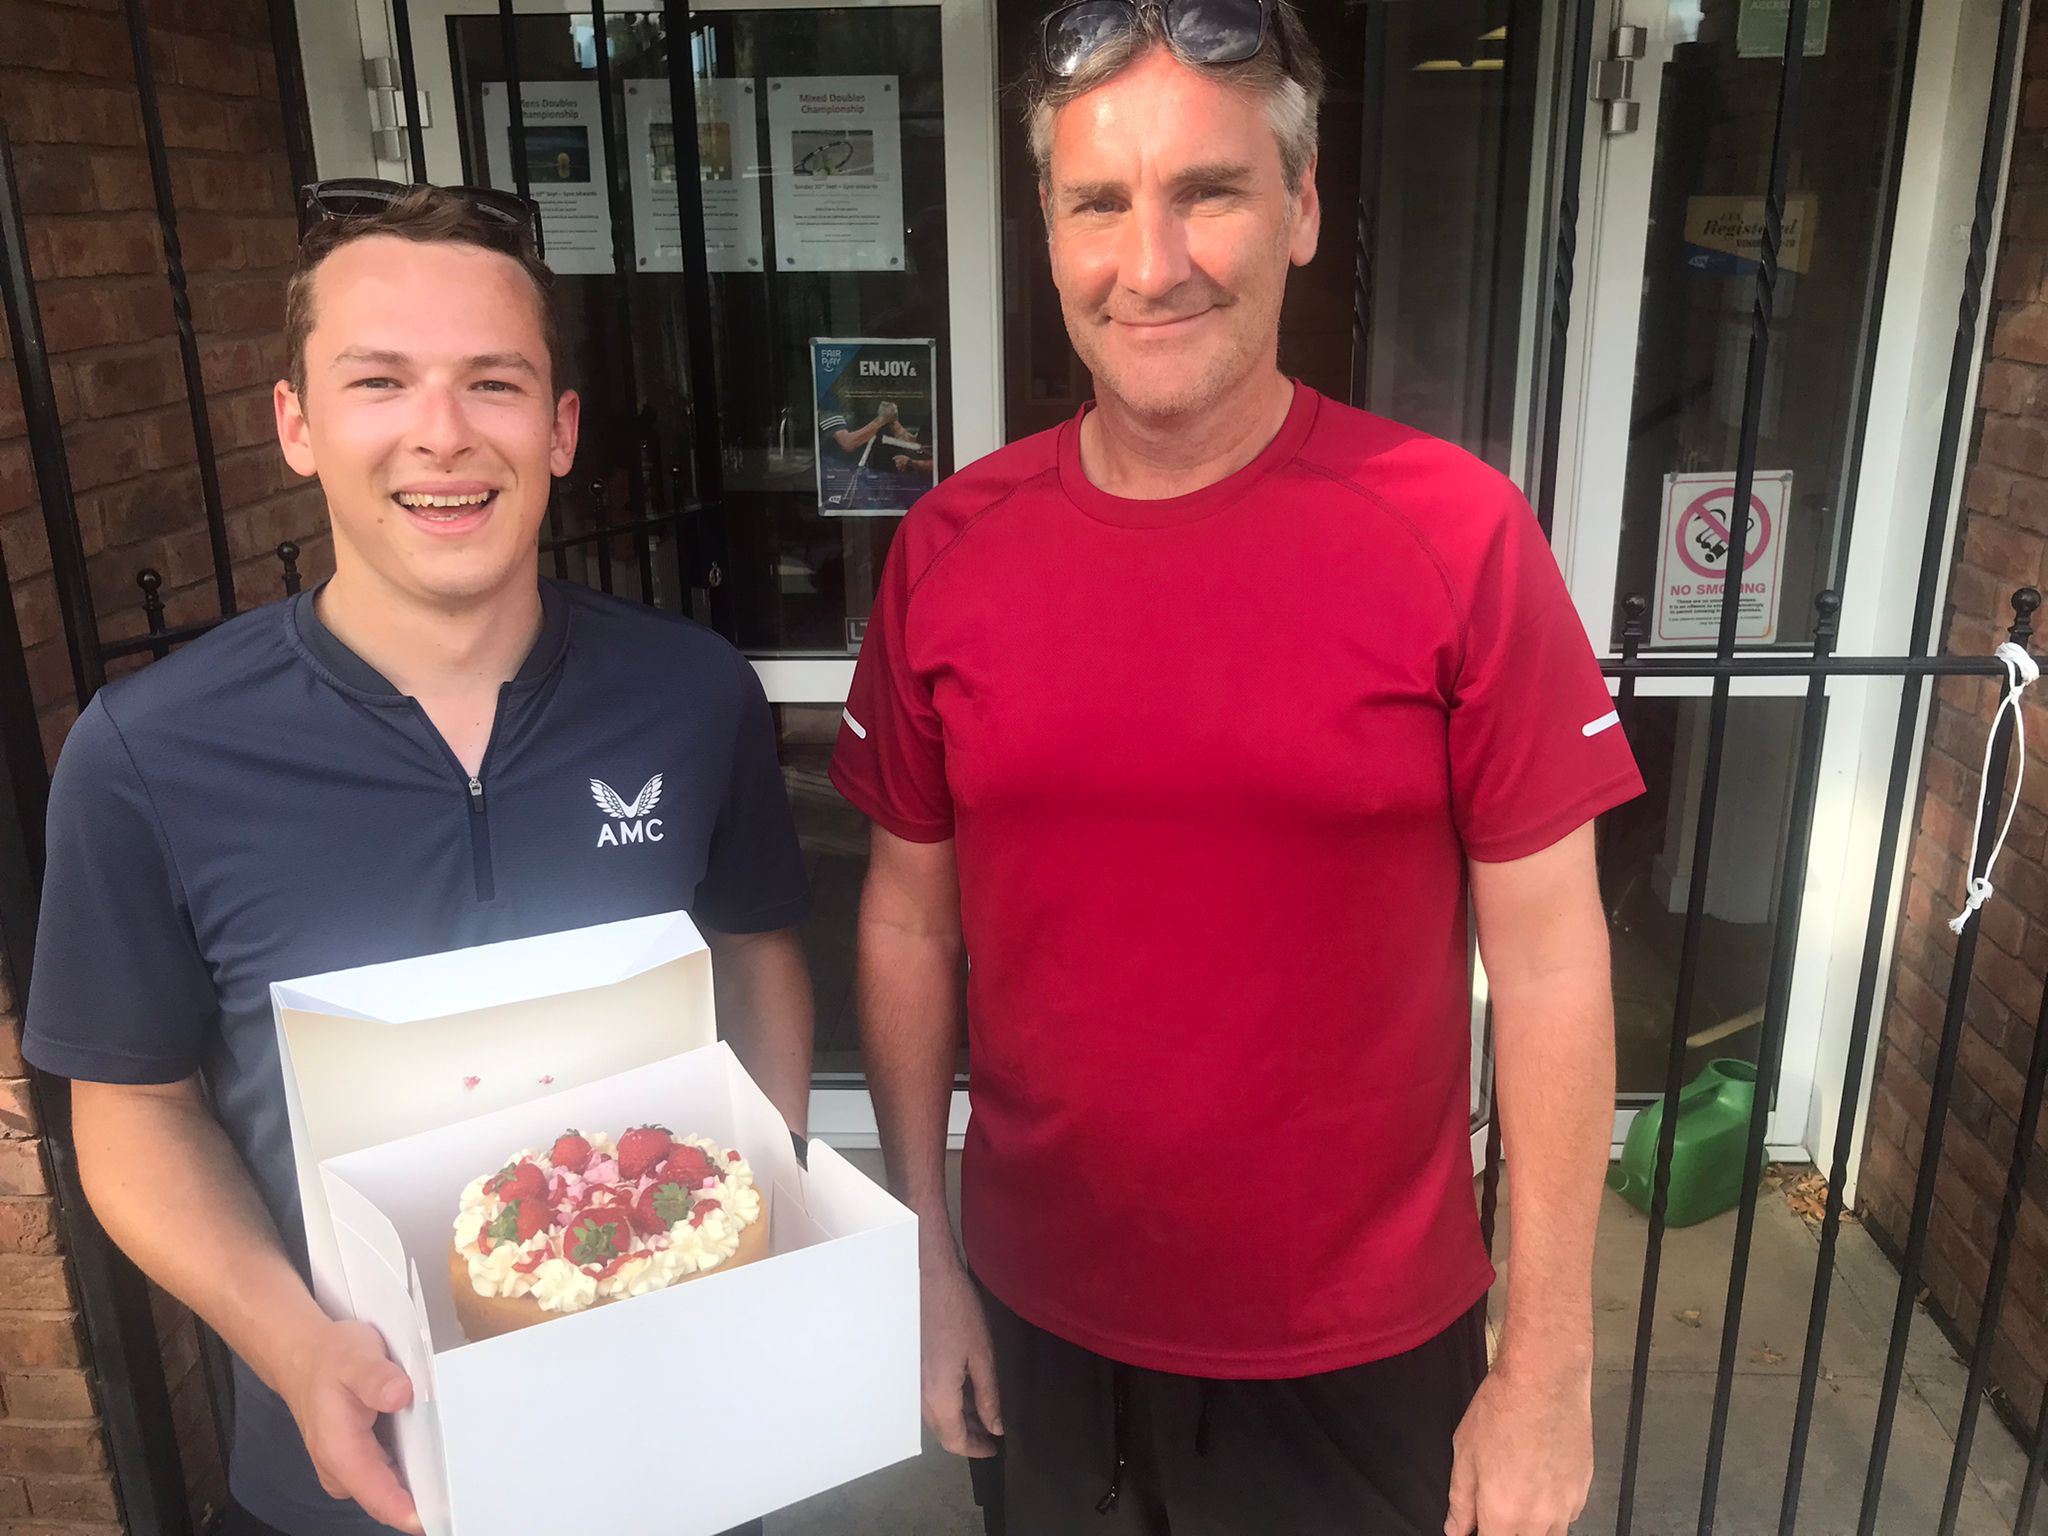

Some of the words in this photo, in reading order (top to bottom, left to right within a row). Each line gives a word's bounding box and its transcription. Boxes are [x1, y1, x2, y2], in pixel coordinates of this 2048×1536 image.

[542, 98, 578, 107] Doubles
[799, 94, 827, 103] Mixed
[829, 93, 865, 103] Doubles
[801, 104, 865, 115] Championship
[821, 349, 842, 358] FAIR
[821, 358, 841, 368] PLAY
[1670, 584, 1692, 596] NO
[1696, 583, 1766, 595] SMOING
[596, 818, 665, 848] AMC
